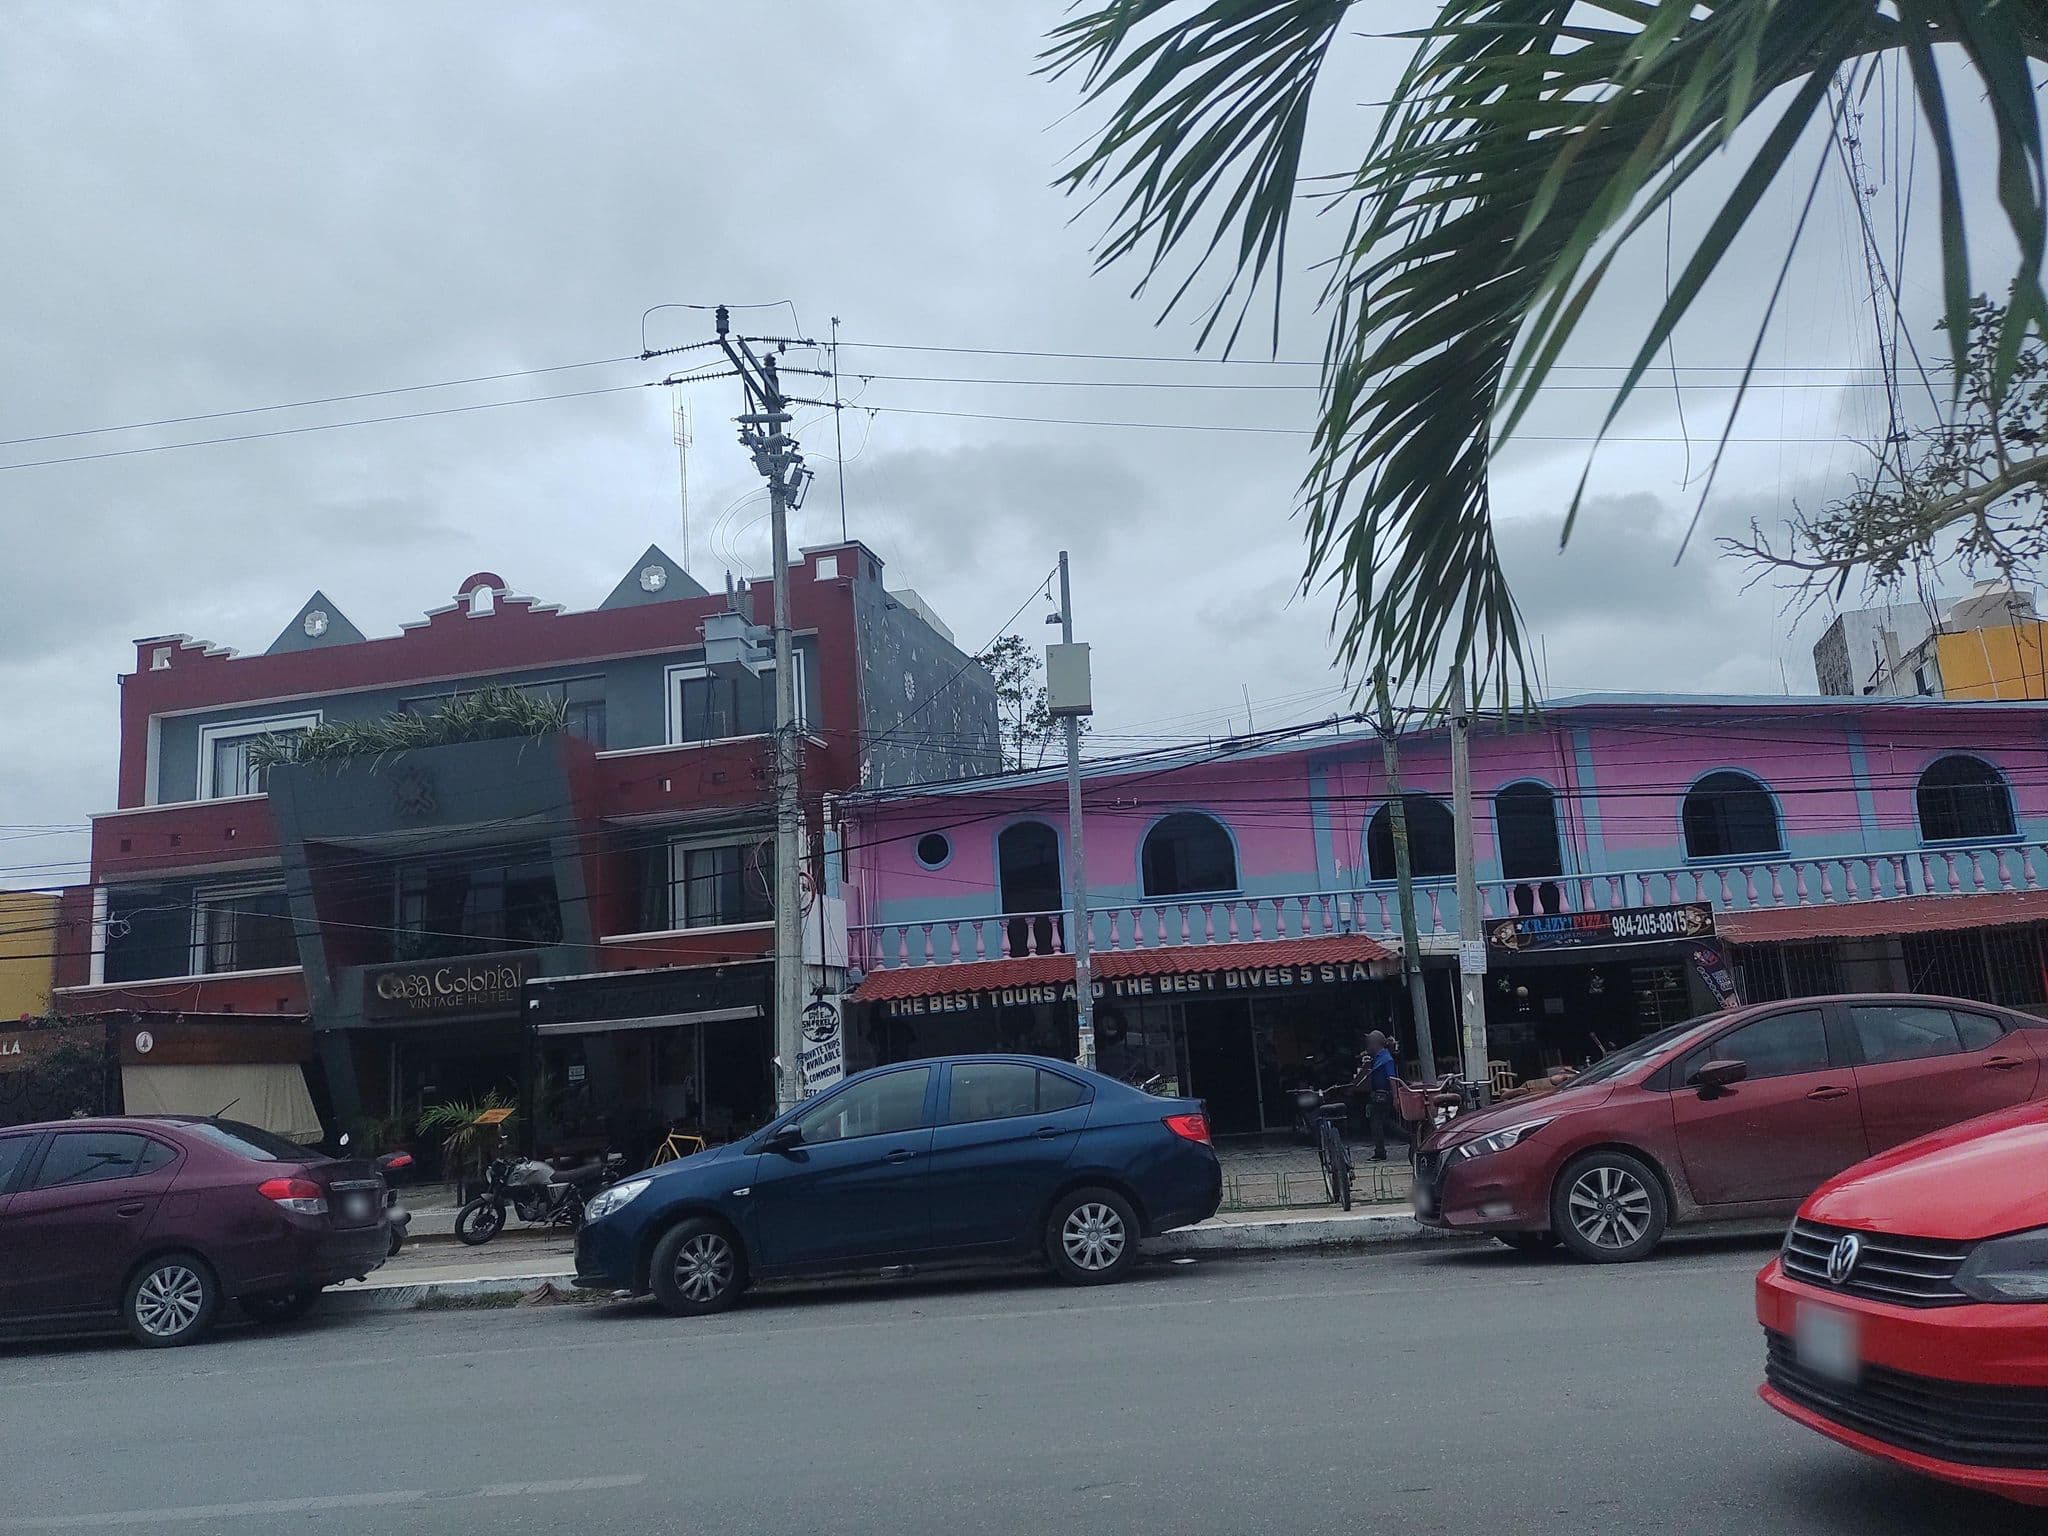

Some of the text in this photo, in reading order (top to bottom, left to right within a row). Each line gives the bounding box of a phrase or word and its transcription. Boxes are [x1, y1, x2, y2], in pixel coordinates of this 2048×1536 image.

[1612, 910, 1687, 937] 984-205-8815
[377, 963, 521, 1000] Casa Colonial
[888, 999, 926, 1017] THE
[929, 992, 980, 1014] BEST
[987, 986, 1057, 1008] TOURS
[1061, 981, 1105, 1001] AD
[1111, 977, 1154, 996] THE
[1159, 972, 1217, 993] BEST
[1225, 967, 1295, 989] DIVES
[1300, 966, 1314, 984] 5
[409, 990, 514, 1009] VINTAGE HOTEL
[0, 1040, 21, 1055] LA
[824, 1038, 841, 1052] TRIPS
[806, 1048, 841, 1072] AVAILABLE
[809, 1063, 841, 1083] COMMISION
